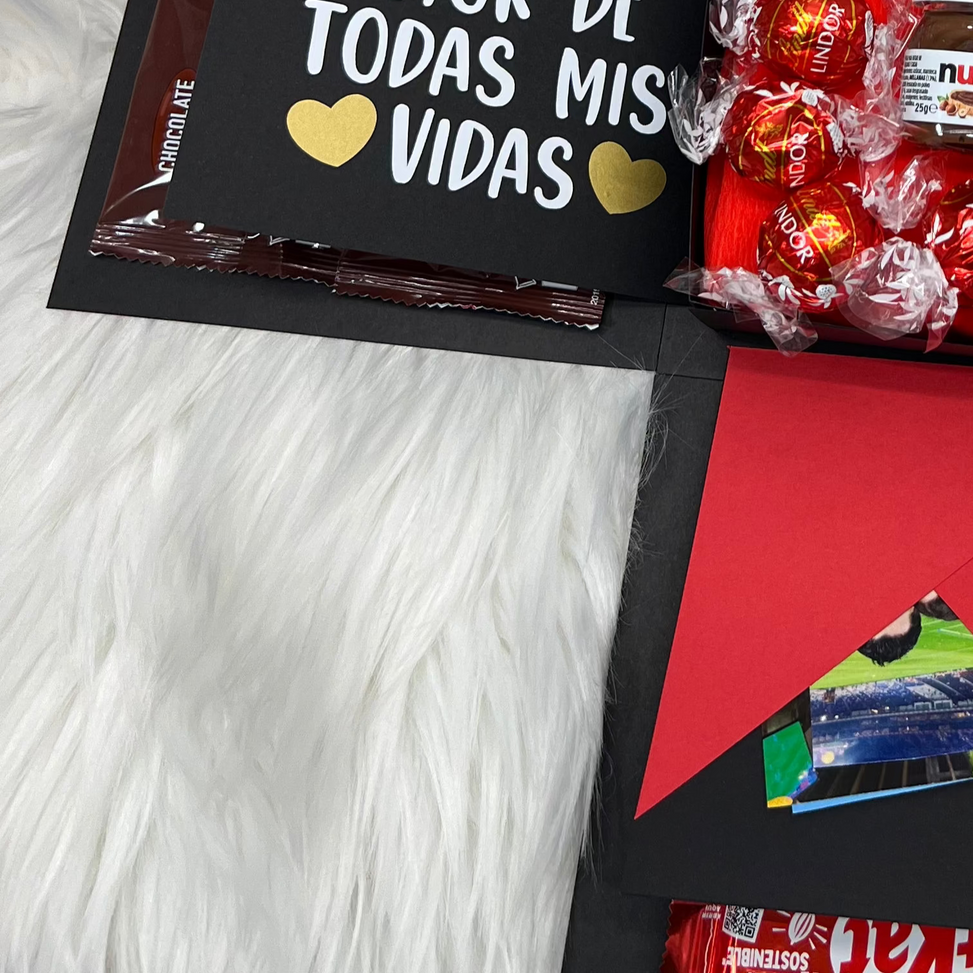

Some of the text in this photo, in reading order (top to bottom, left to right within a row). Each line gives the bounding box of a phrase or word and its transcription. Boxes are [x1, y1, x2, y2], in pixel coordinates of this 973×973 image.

[810, 3, 846, 73] LINDOR
[158, 78, 196, 172] CHOCOLATE
[555, 46, 669, 135] MIS
[391, 103, 575, 210] VIDAS
[788, 132, 810, 188] NDOR
[774, 200, 815, 265] INDOR
